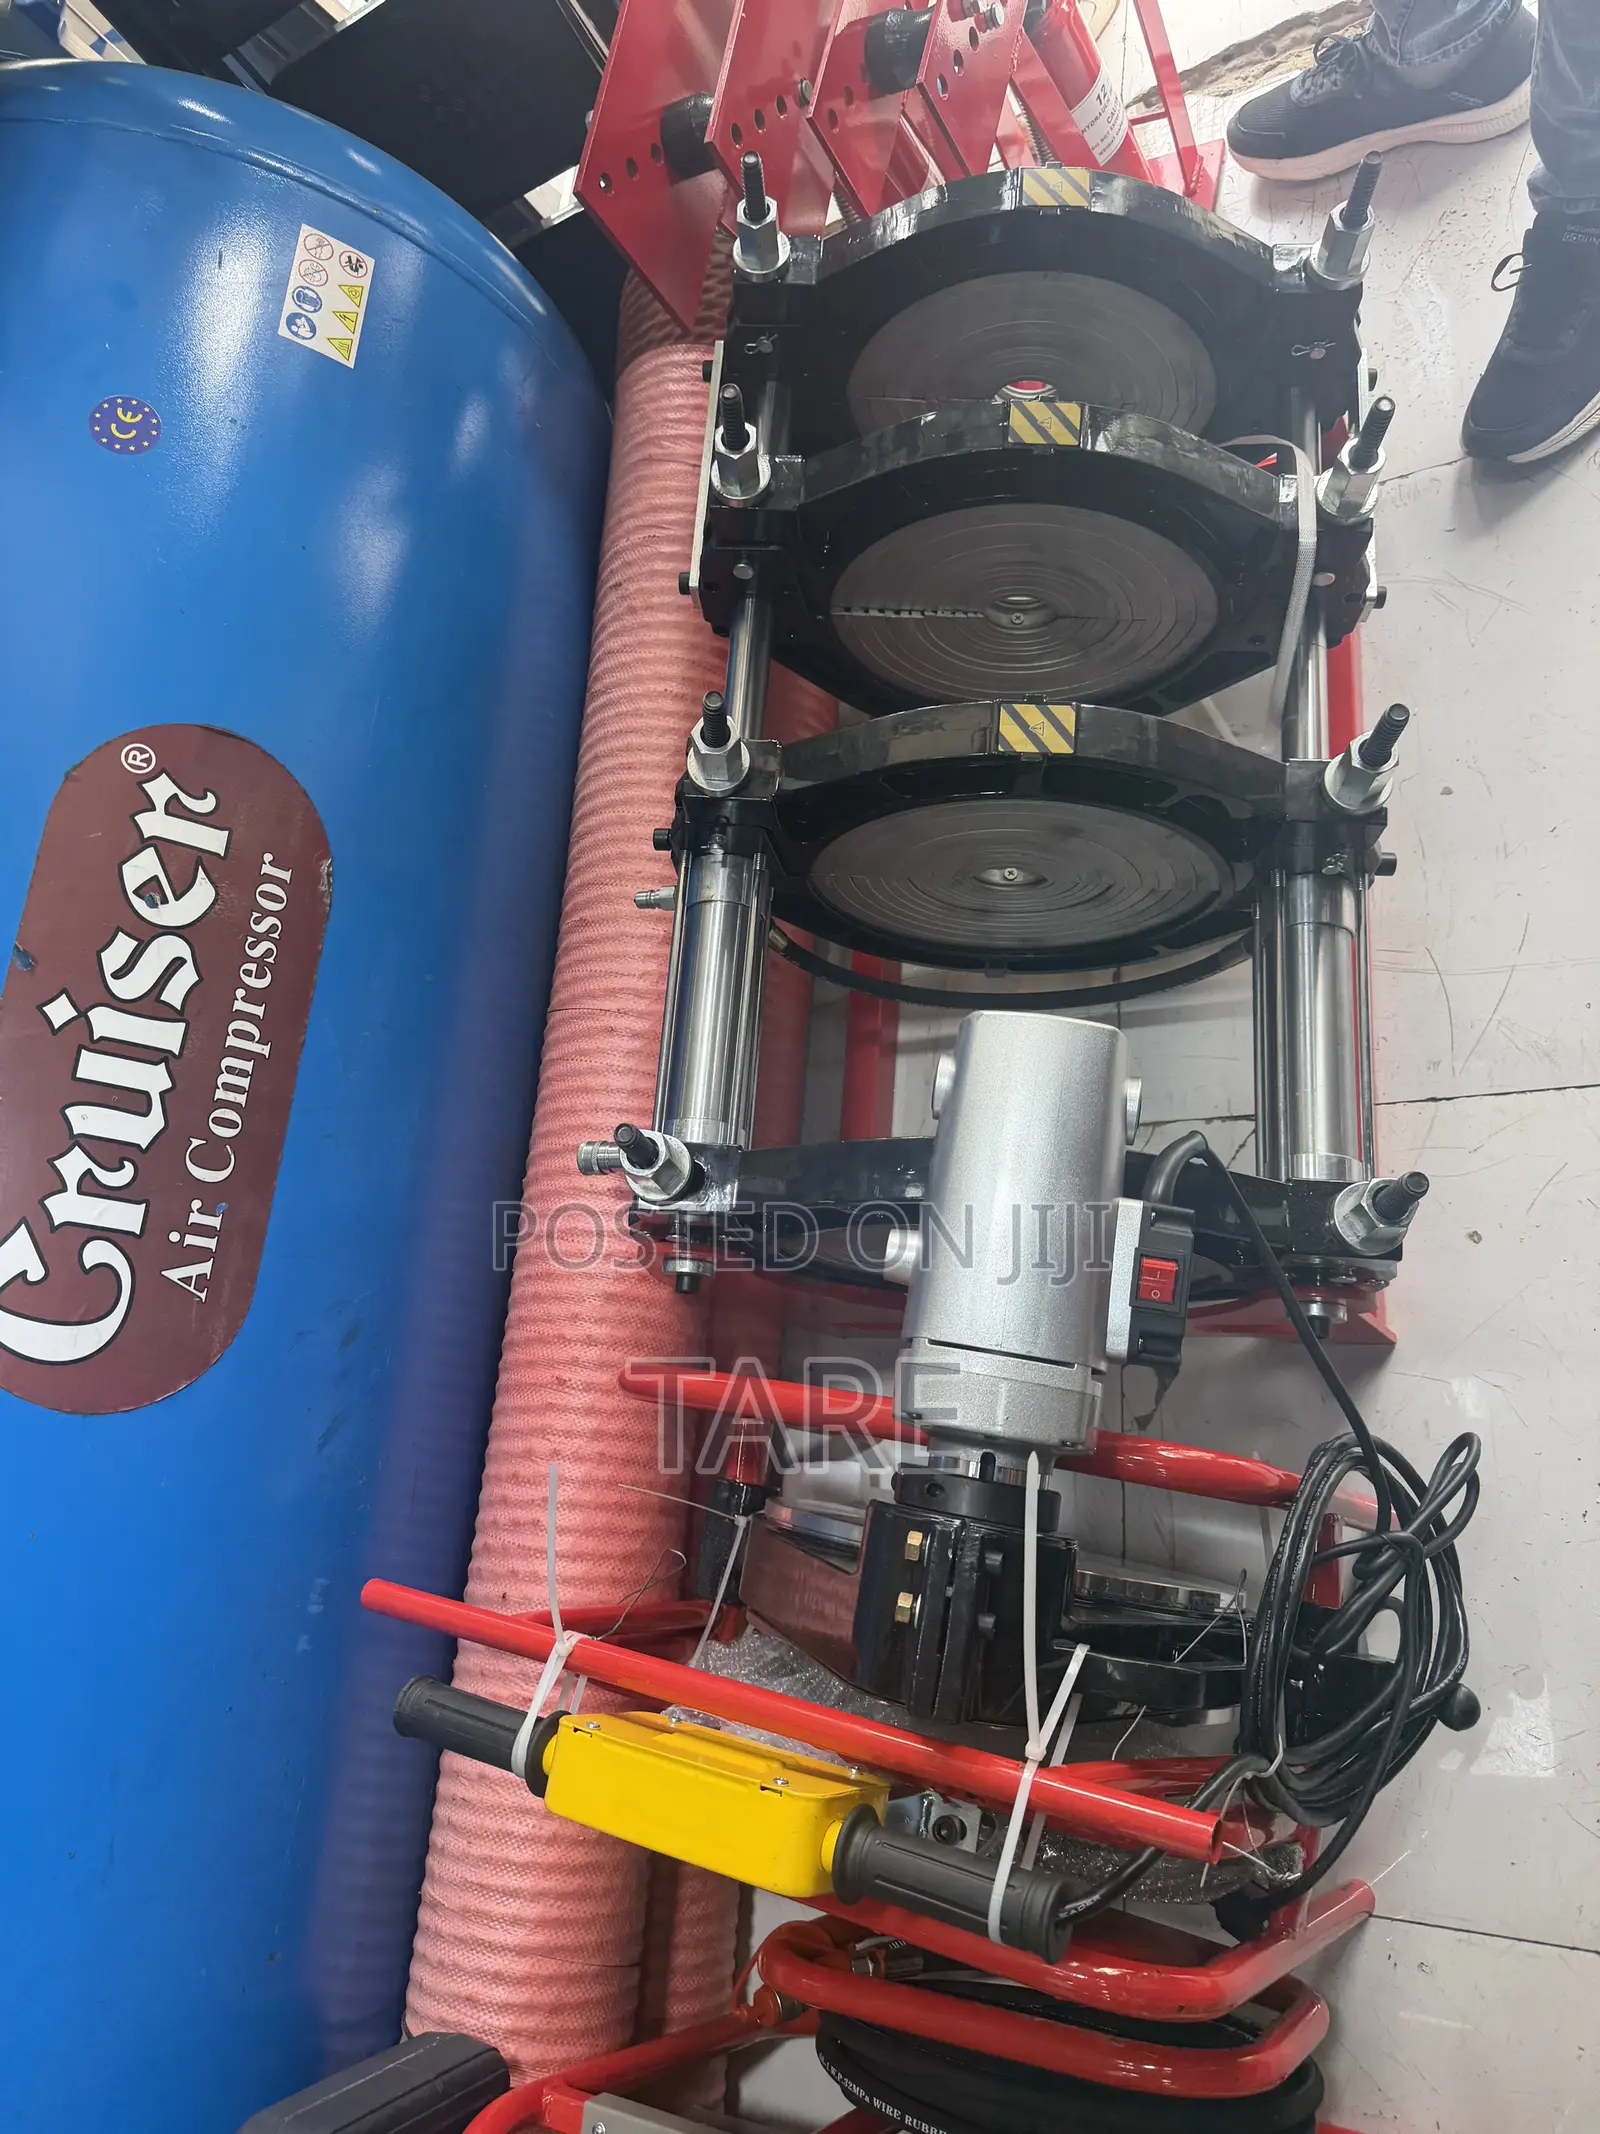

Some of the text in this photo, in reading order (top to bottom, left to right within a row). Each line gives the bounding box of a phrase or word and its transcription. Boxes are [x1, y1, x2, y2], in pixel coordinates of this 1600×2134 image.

[110, 407, 143, 439] CE
[161, 852, 294, 1303] Air Compressor
[872, 2096, 902, 2120] WIRE
